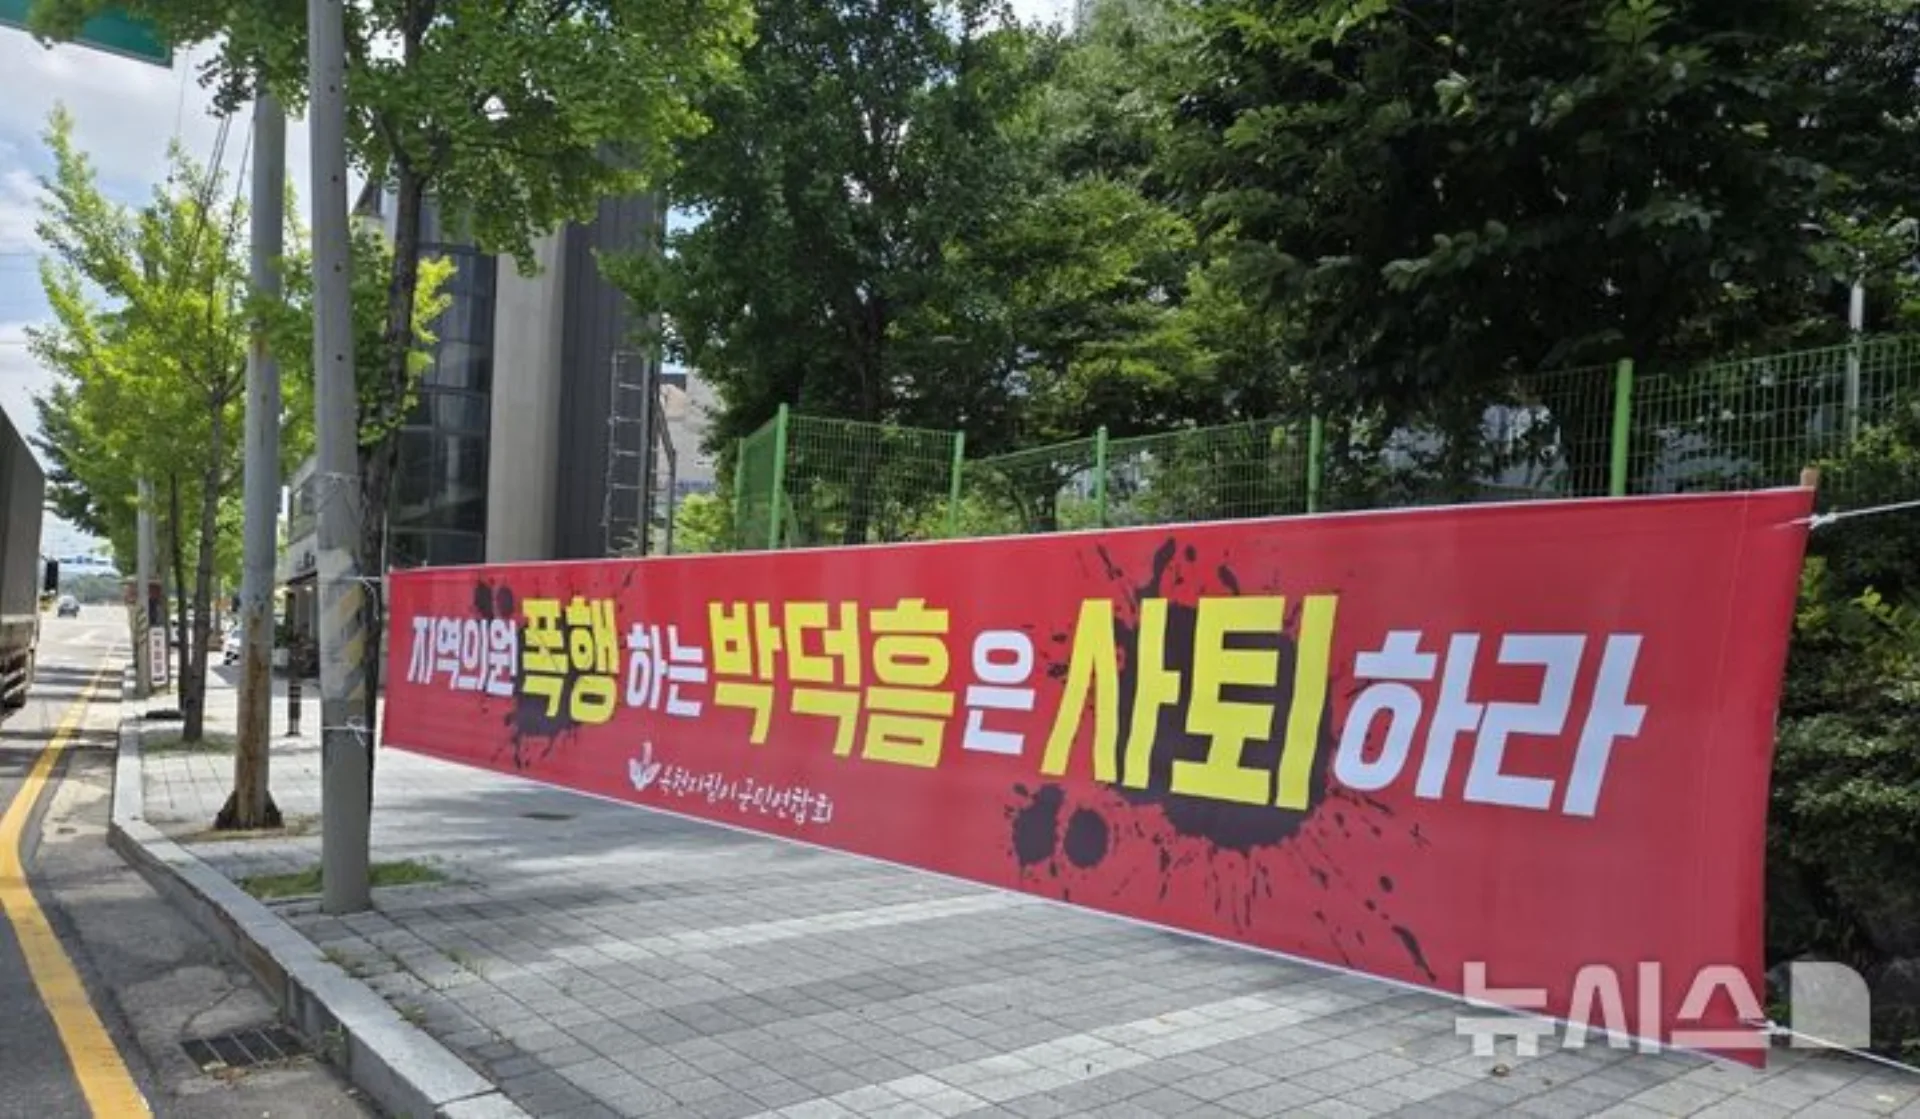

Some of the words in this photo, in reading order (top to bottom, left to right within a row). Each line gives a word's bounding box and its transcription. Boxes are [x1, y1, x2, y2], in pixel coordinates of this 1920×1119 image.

[408, 616, 518, 697] 지역의원
[519, 595, 708, 725] 폭행하는
[708, 598, 1036, 768] 박덕흠은
[1040, 595, 1648, 818] 사퇴하라
